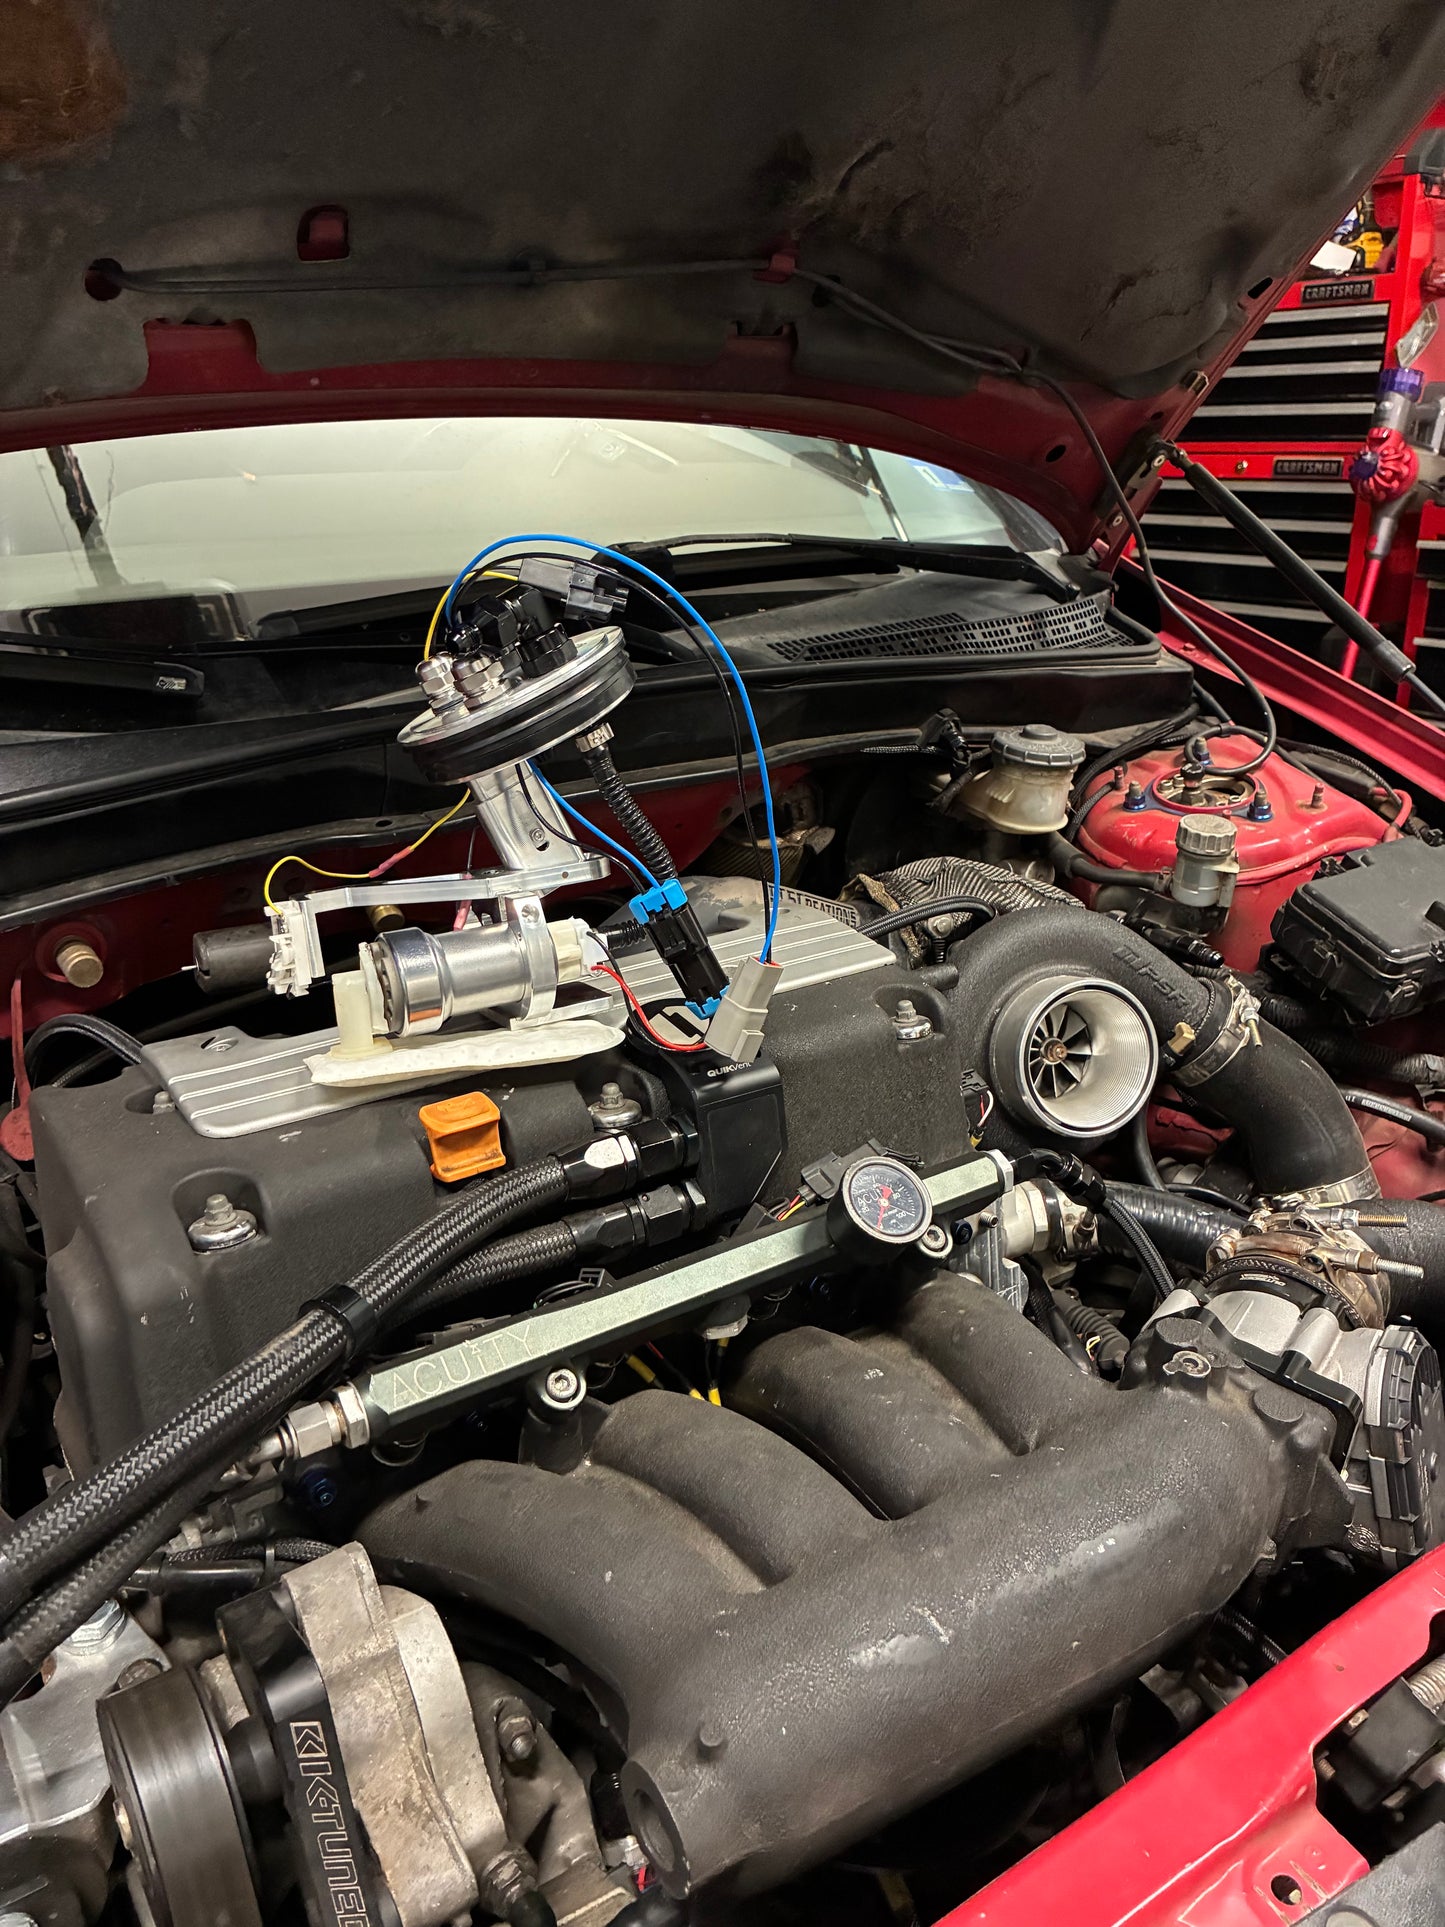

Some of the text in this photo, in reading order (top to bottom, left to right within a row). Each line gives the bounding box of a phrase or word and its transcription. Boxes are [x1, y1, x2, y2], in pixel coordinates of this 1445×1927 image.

[1305, 283, 1370, 299] CRAFTSMAN
[1276, 461, 1339, 474] CRAFTSMAN
[391, 1324, 533, 1408] ACUITY
